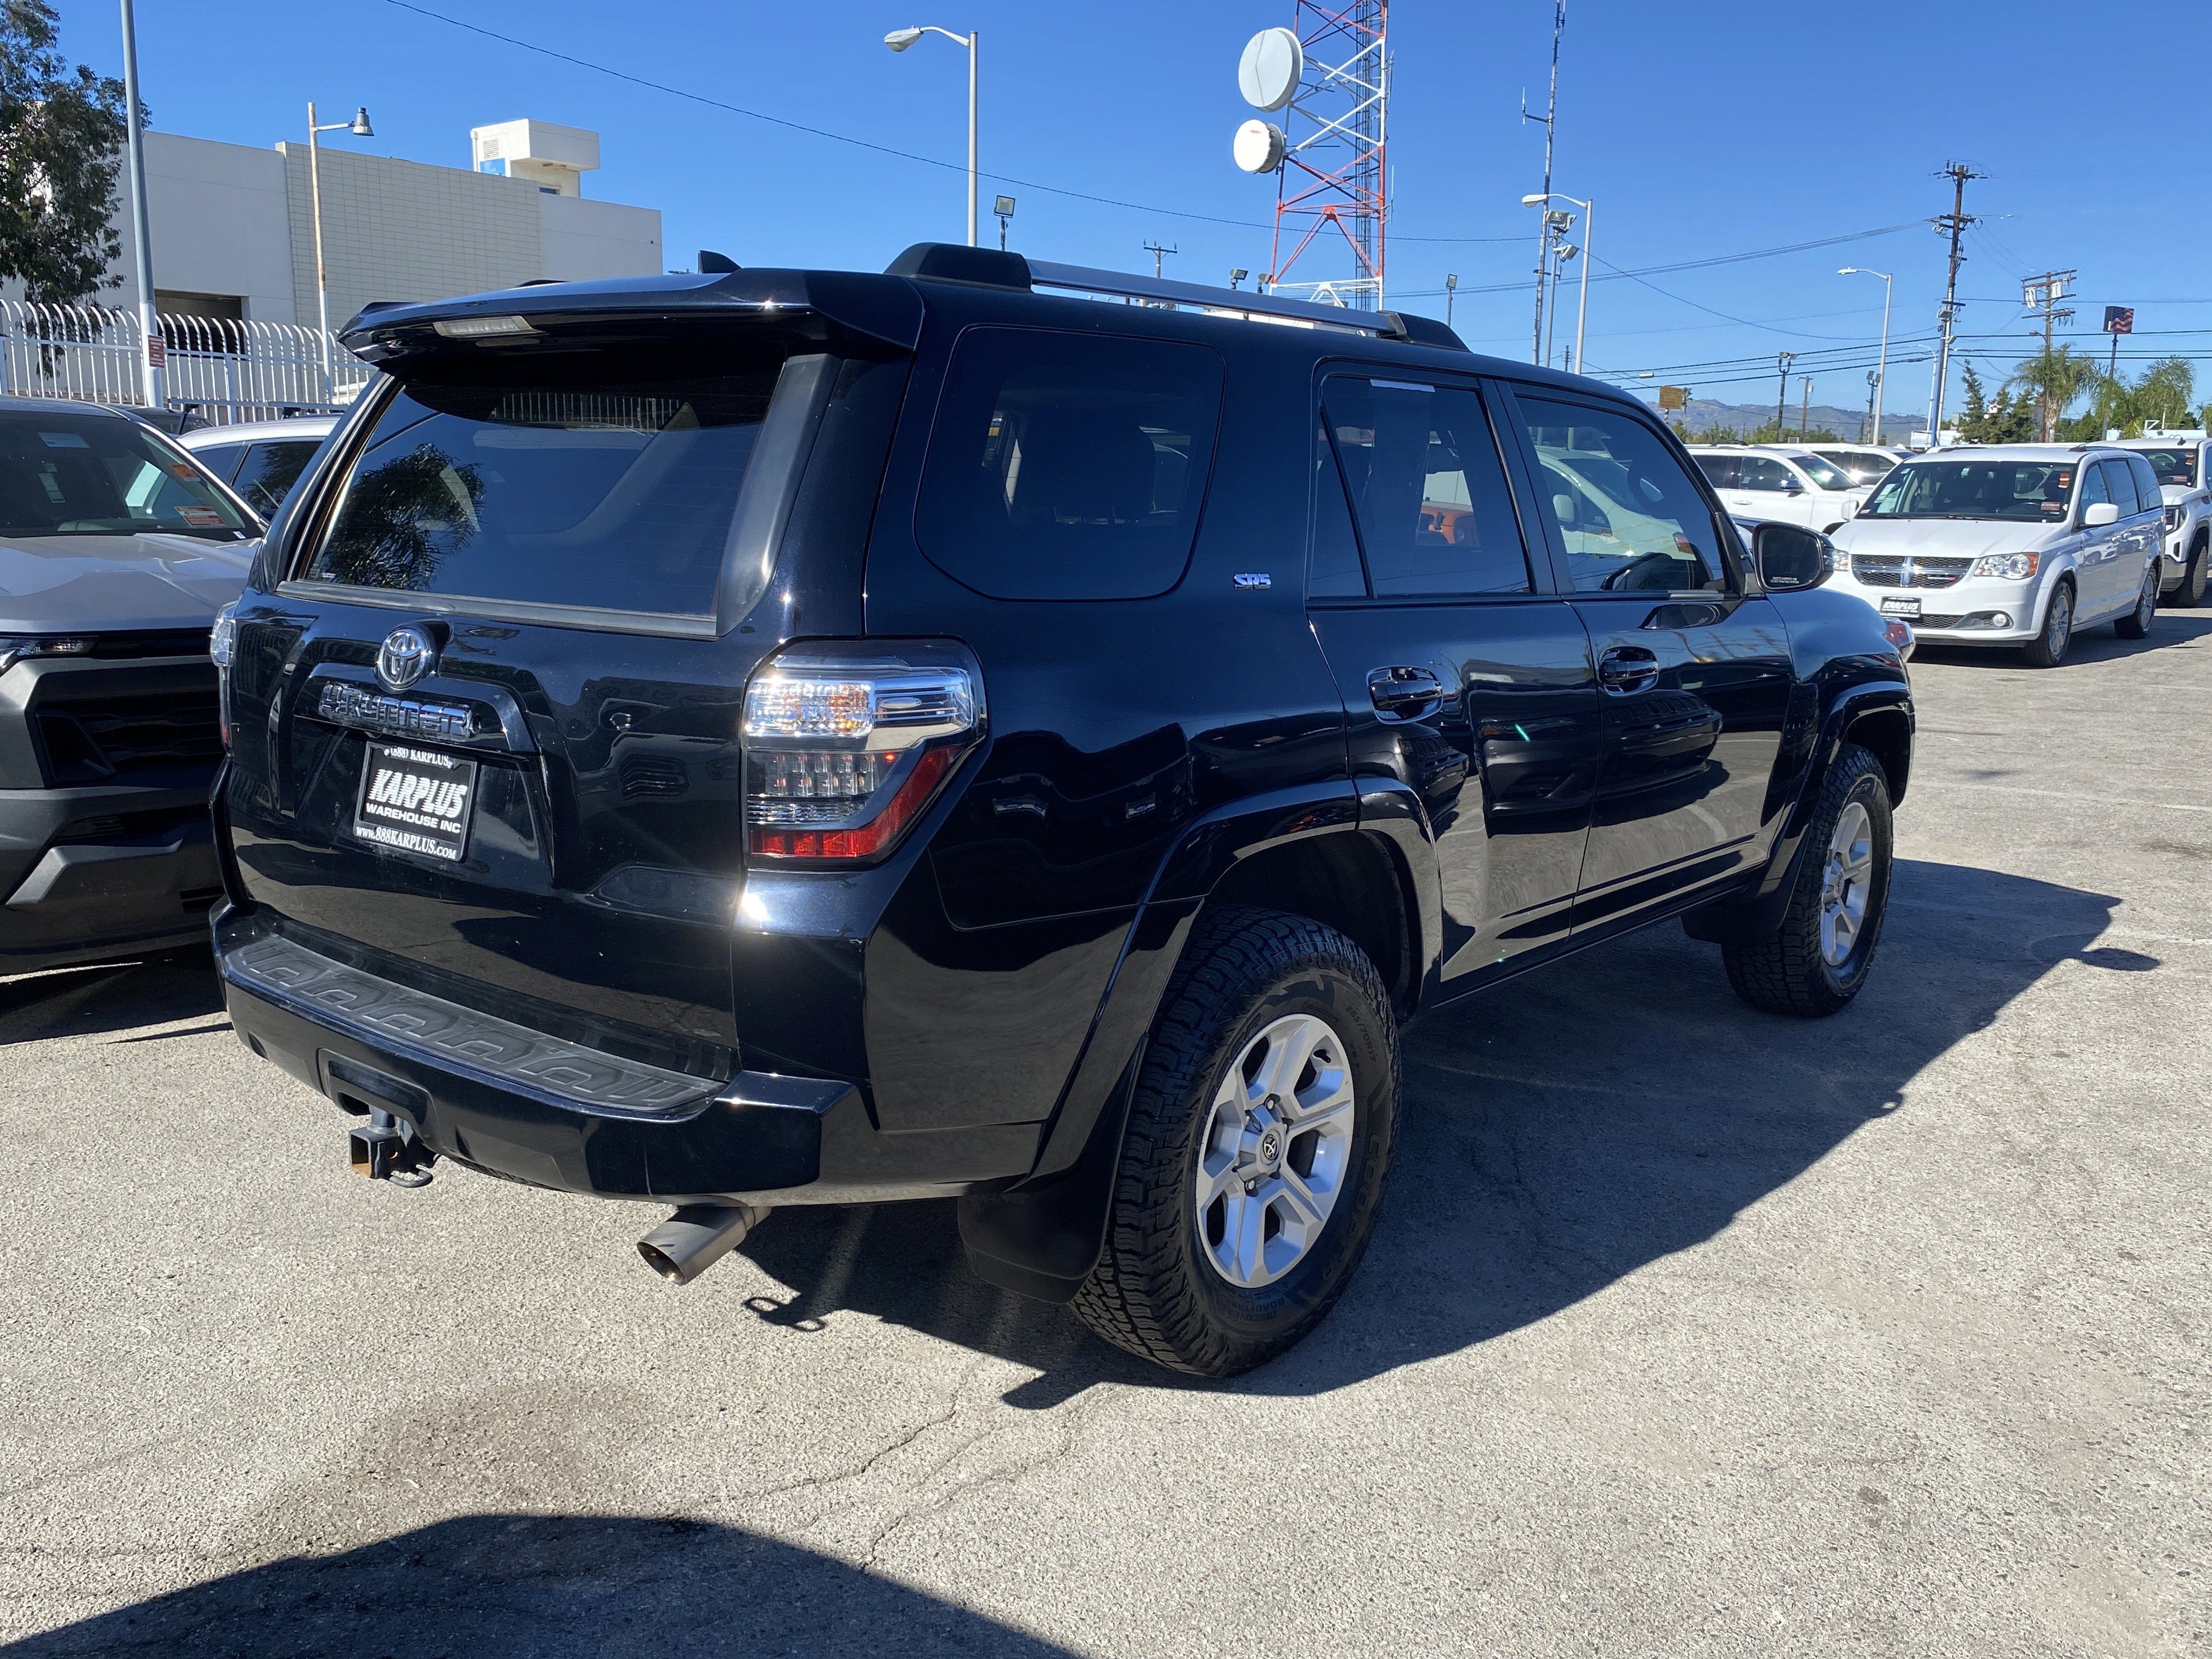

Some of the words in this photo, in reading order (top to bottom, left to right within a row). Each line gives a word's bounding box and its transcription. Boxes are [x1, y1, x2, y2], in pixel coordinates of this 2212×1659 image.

[1234, 573, 1271, 590] SR5
[1883, 601, 1920, 610] KARPLUS
[390, 746, 409, 758] (888)
[409, 749, 449, 766] KARPLUS
[368, 769, 468, 818] KARPLUS
[366, 803, 437, 828] WAREHOUSE
[439, 820, 461, 833] INC
